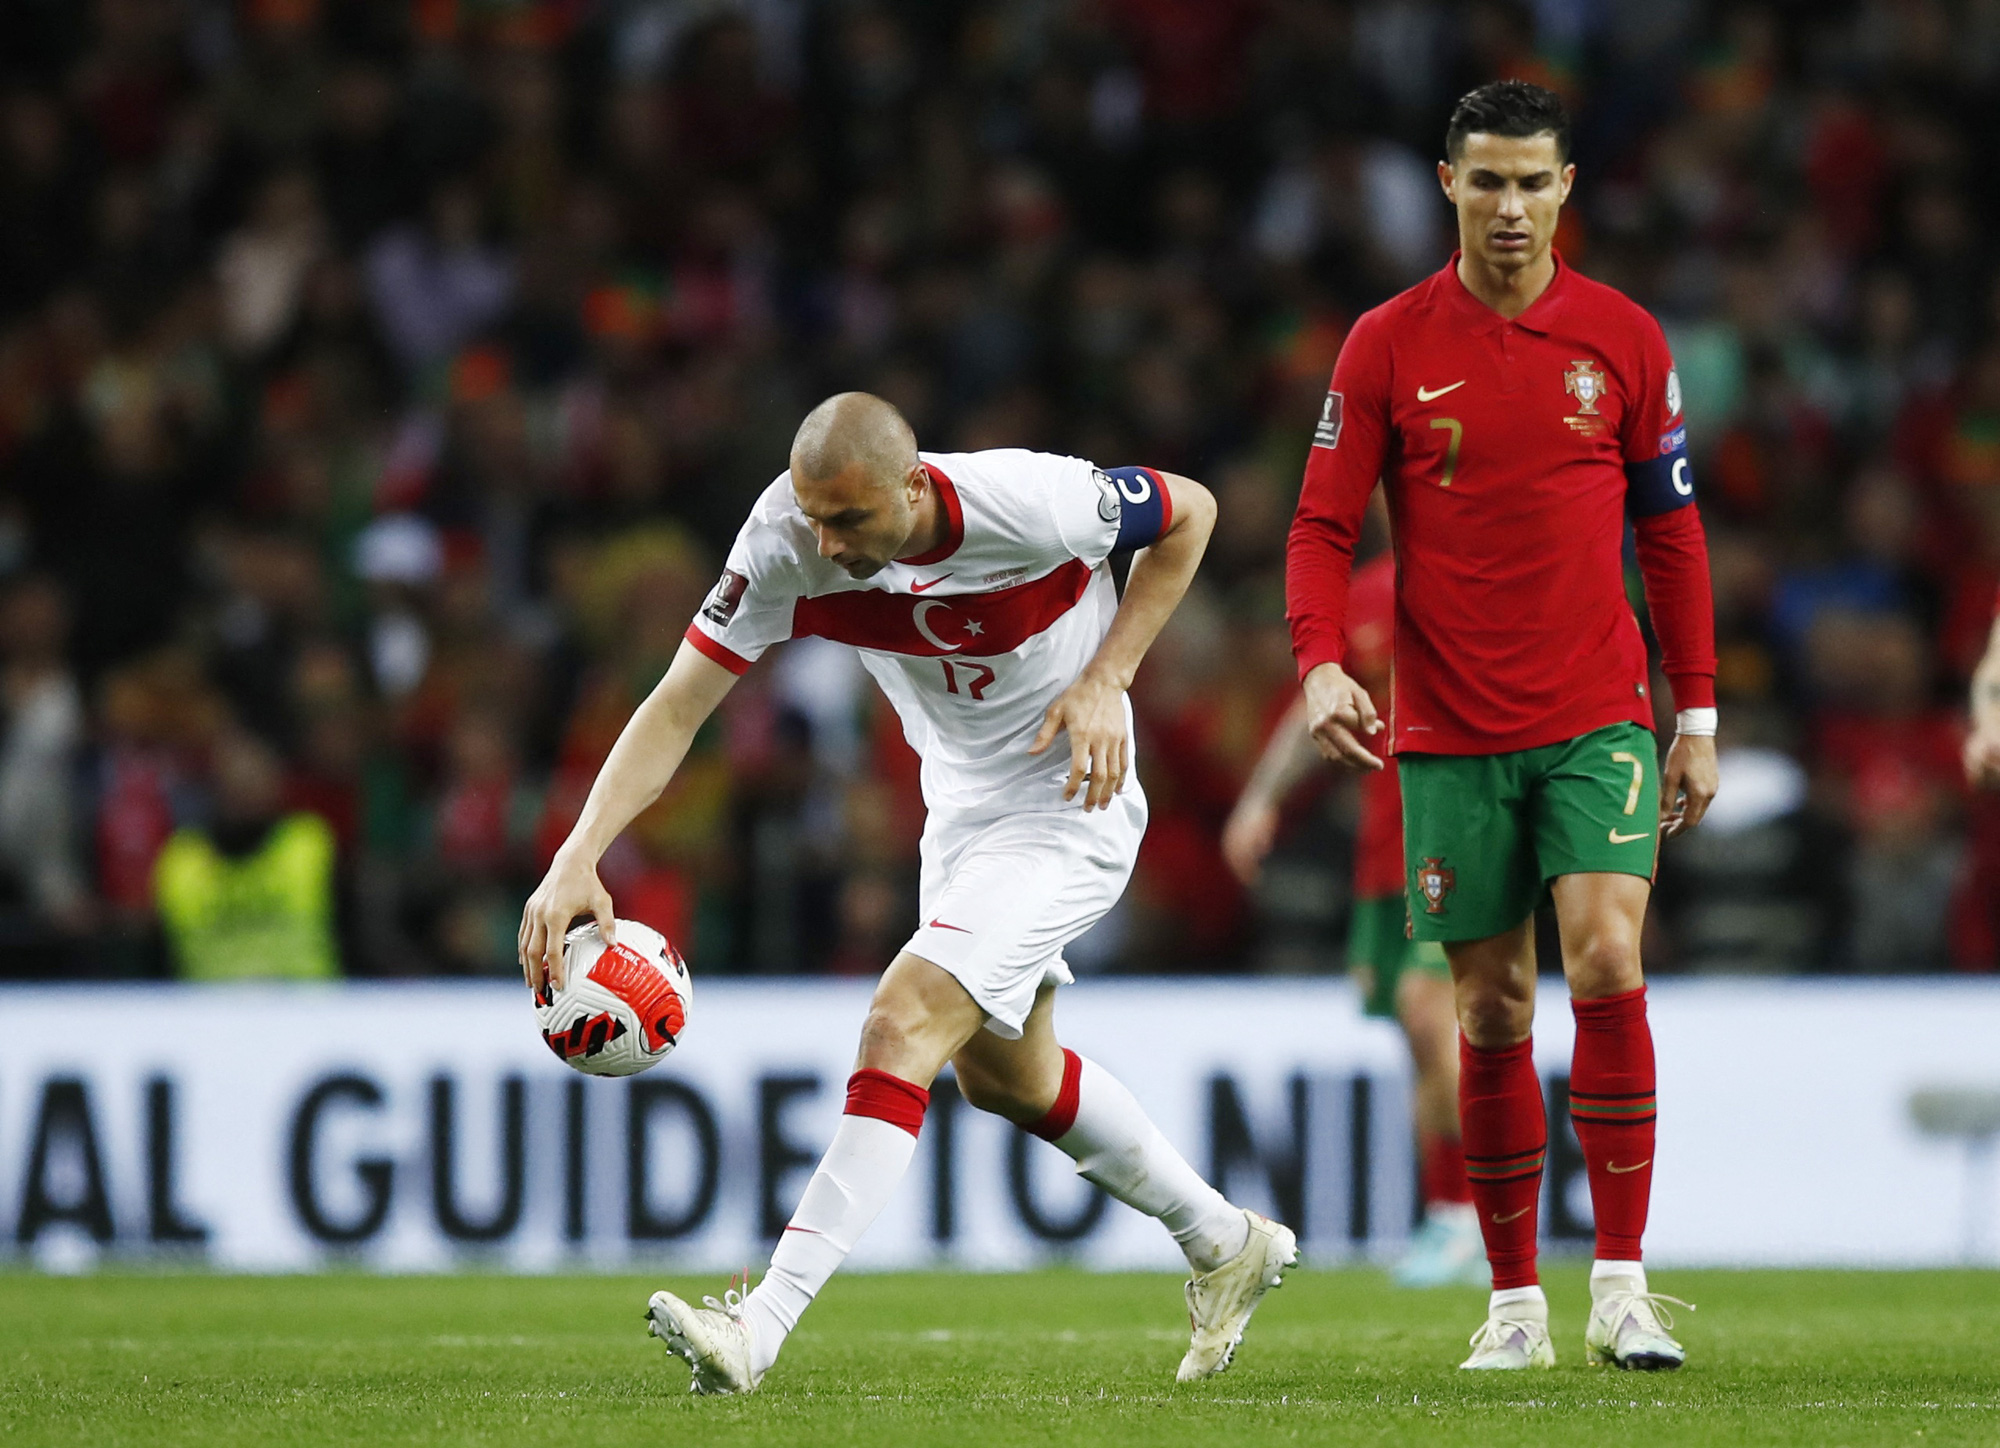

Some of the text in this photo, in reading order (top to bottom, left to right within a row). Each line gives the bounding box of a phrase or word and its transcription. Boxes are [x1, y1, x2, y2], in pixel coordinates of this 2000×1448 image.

[1429, 418, 1463, 487] 7
[1671, 456, 1693, 496] C
[1116, 474, 1152, 504] C
[937, 658, 996, 701] 17
[1611, 751, 1643, 816] 7
[15, 1078, 209, 1241] AL
[288, 1074, 820, 1242] GUIDE
[1208, 1074, 1597, 1242] NIE
